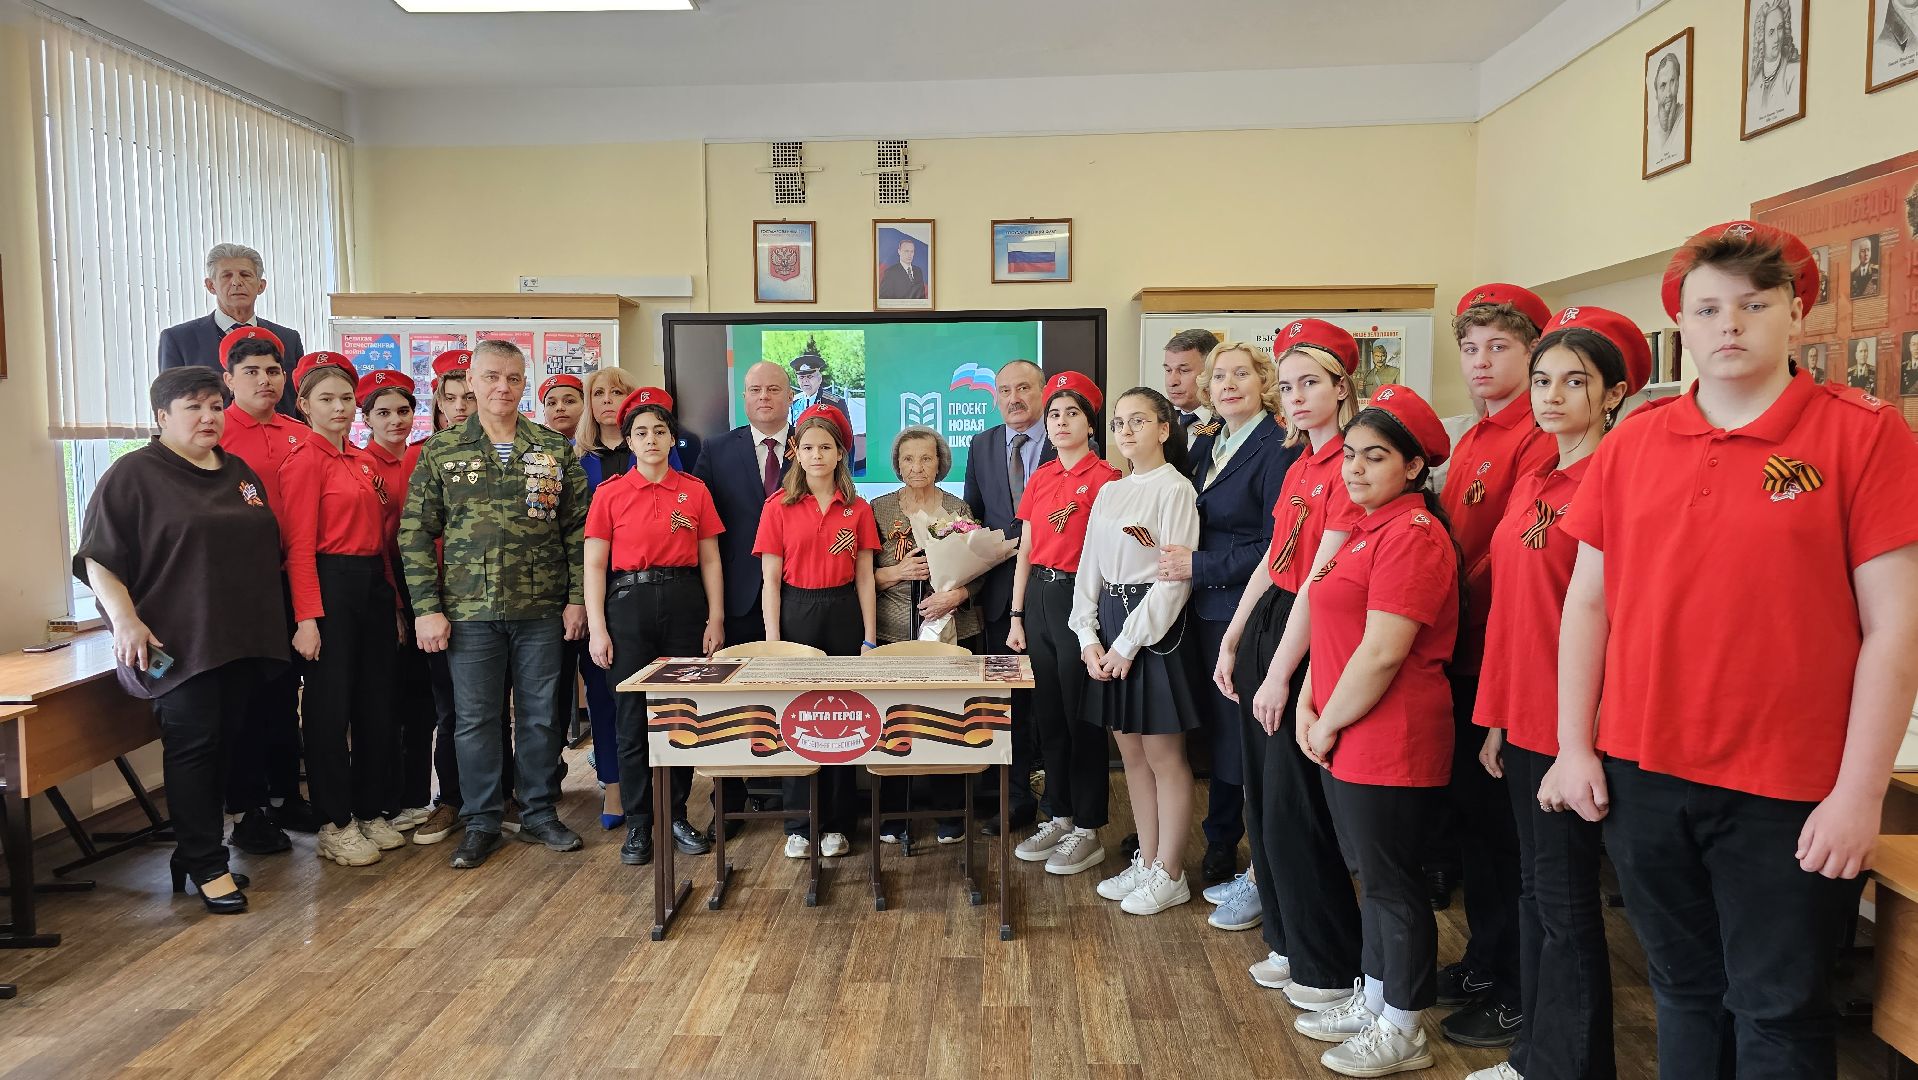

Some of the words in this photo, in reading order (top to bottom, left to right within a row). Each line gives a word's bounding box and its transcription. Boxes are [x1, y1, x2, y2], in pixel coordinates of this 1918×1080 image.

[948, 402, 987, 415] ПРОЕКТ
[948, 418, 985, 432] НОВАЯ
[948, 434, 973, 448] ШКО
[798, 710, 831, 721] ПАРТА
[832, 710, 863, 721] ГЕРОЯ
